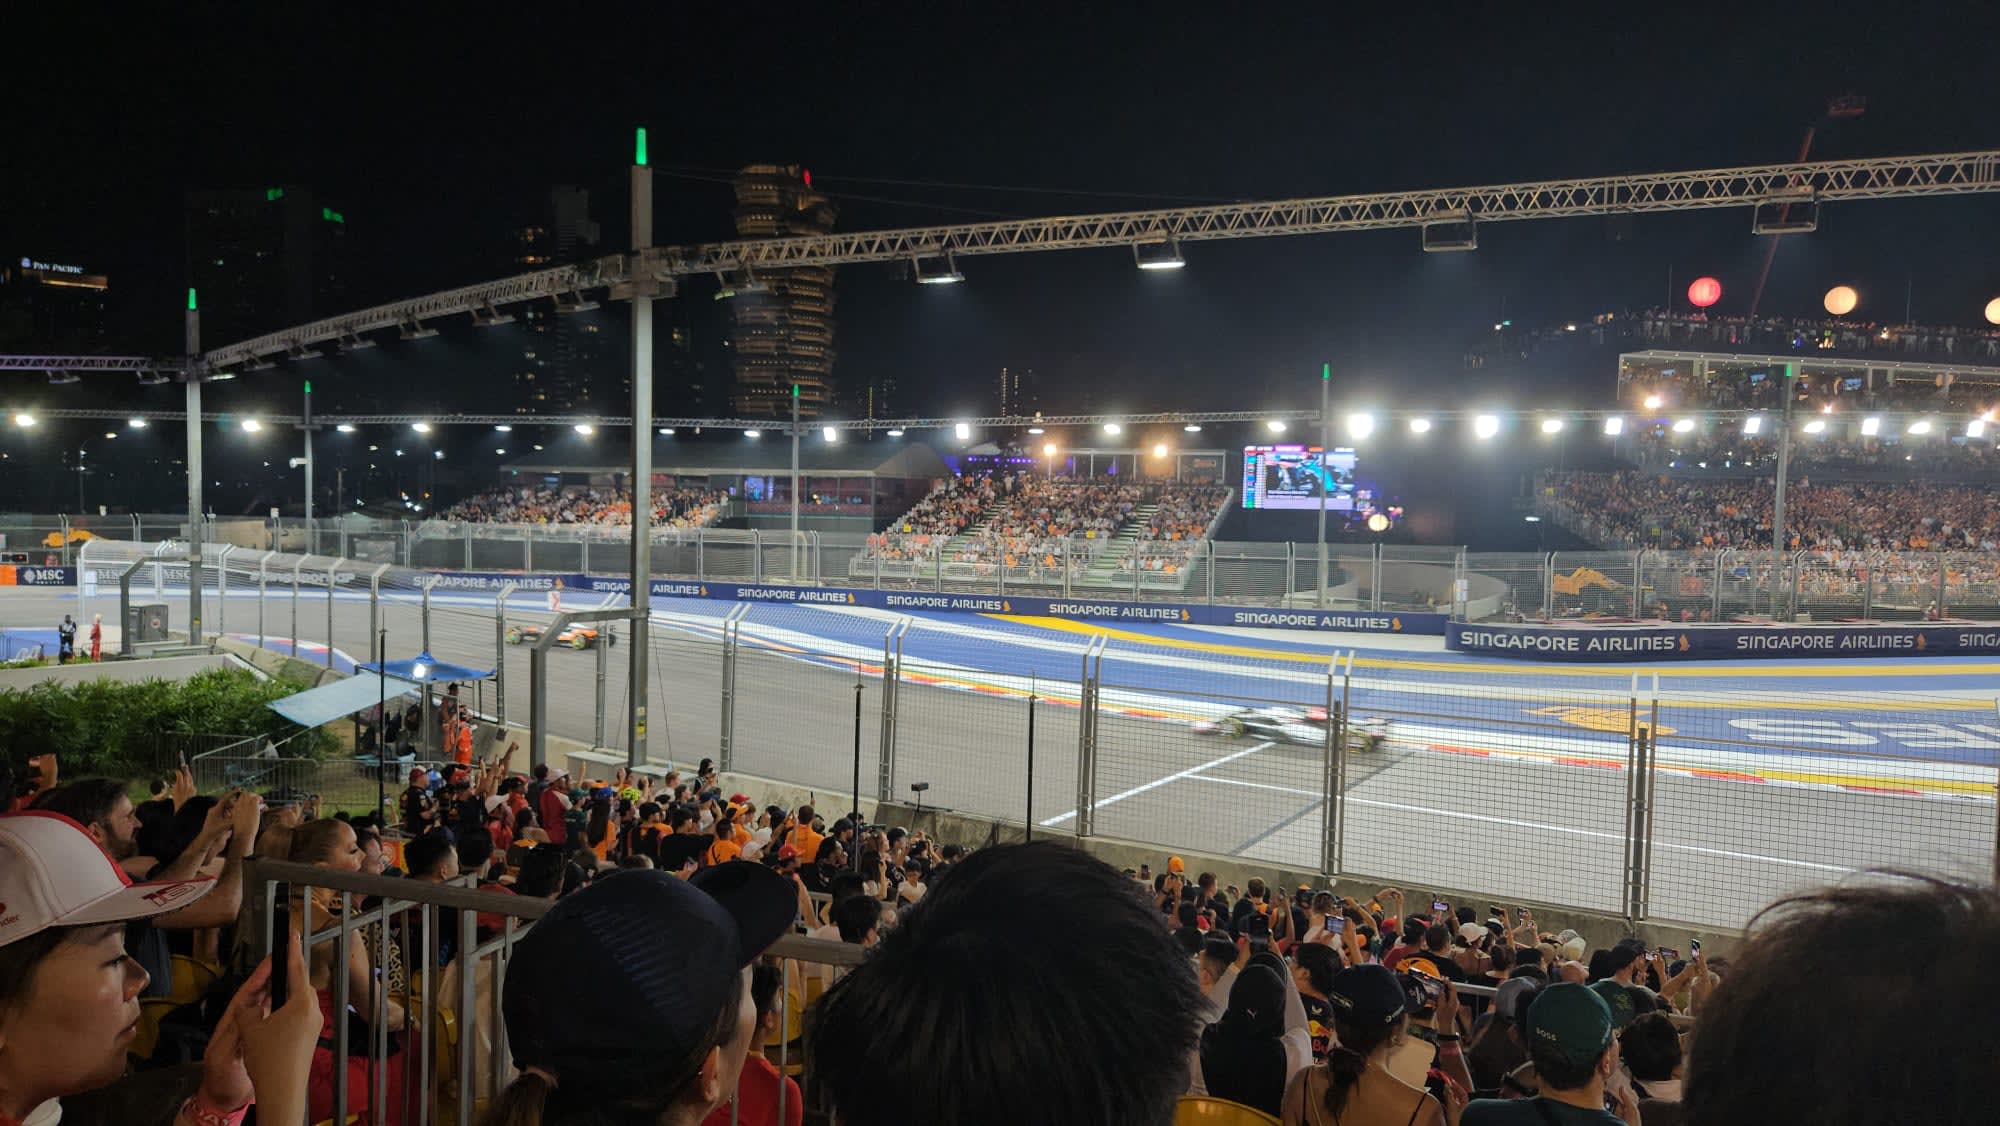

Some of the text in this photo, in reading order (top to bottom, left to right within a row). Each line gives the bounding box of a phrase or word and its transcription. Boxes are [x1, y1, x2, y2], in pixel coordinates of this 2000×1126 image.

[33, 261, 50, 270] PAN
[36, 569, 64, 580] MSC
[592, 582, 700, 594] SINGAP AIRLINES
[737, 588, 846, 602] SINGAPORE AIRLINES
[886, 595, 1002, 610] SINGAPORE AIRLINES
[1049, 603, 1180, 620] SINGAPORE AIRLINES
[1234, 612, 1390, 630] SINGAPORE AIRLINES
[1460, 630, 1676, 652] SINGAPORE AIRLINES
[1736, 635, 1915, 650] SINGAPORE AIRLINES
